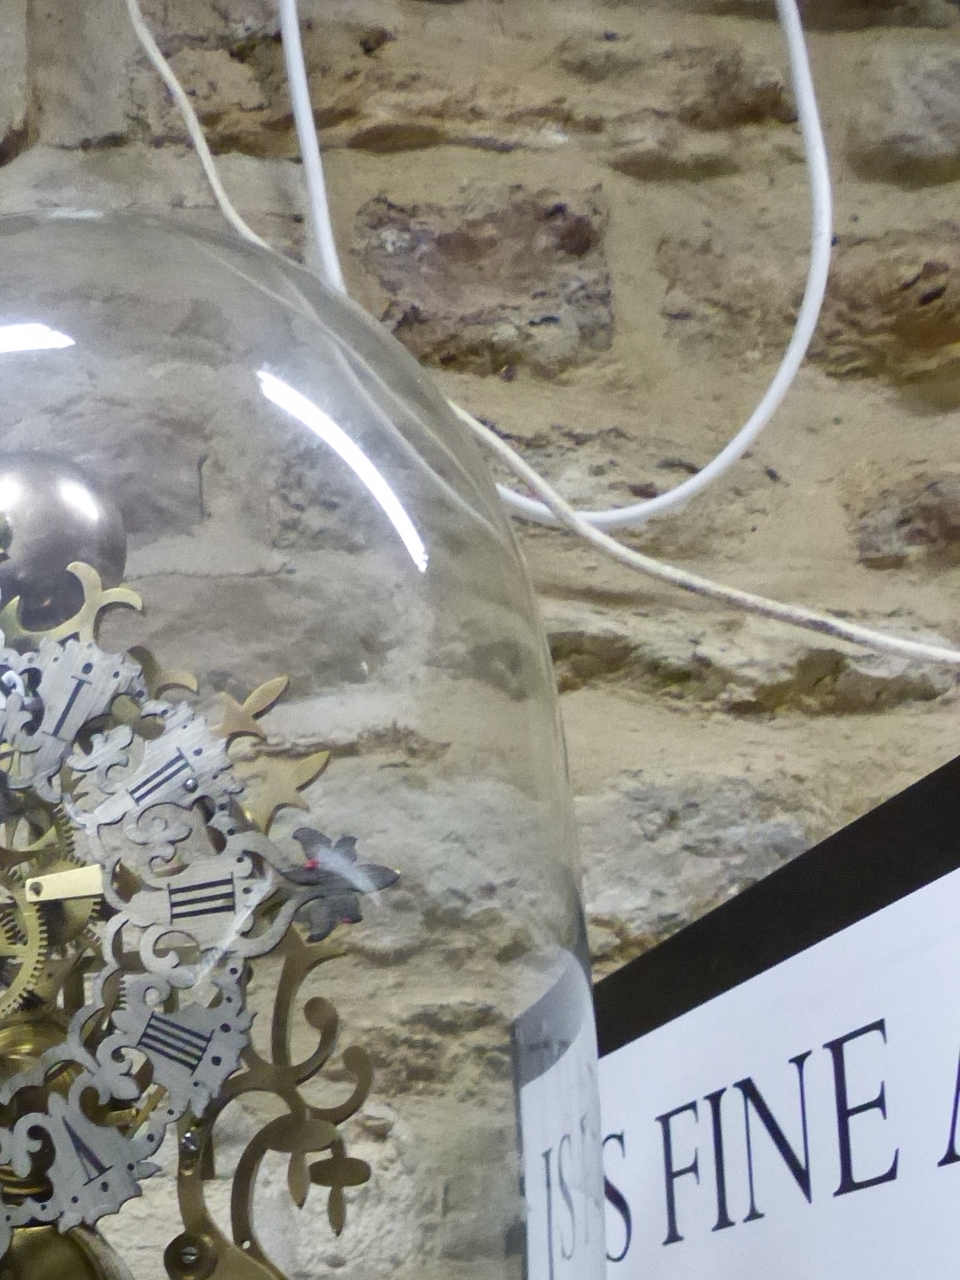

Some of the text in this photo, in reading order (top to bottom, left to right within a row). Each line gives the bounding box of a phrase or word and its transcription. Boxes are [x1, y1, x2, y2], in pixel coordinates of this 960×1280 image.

[126, 747, 195, 806] II
[167, 871, 236, 925] III
[137, 1011, 215, 1077] IIII
[61, 1115, 114, 1187] V
[655, 1018, 900, 1246] FINE
